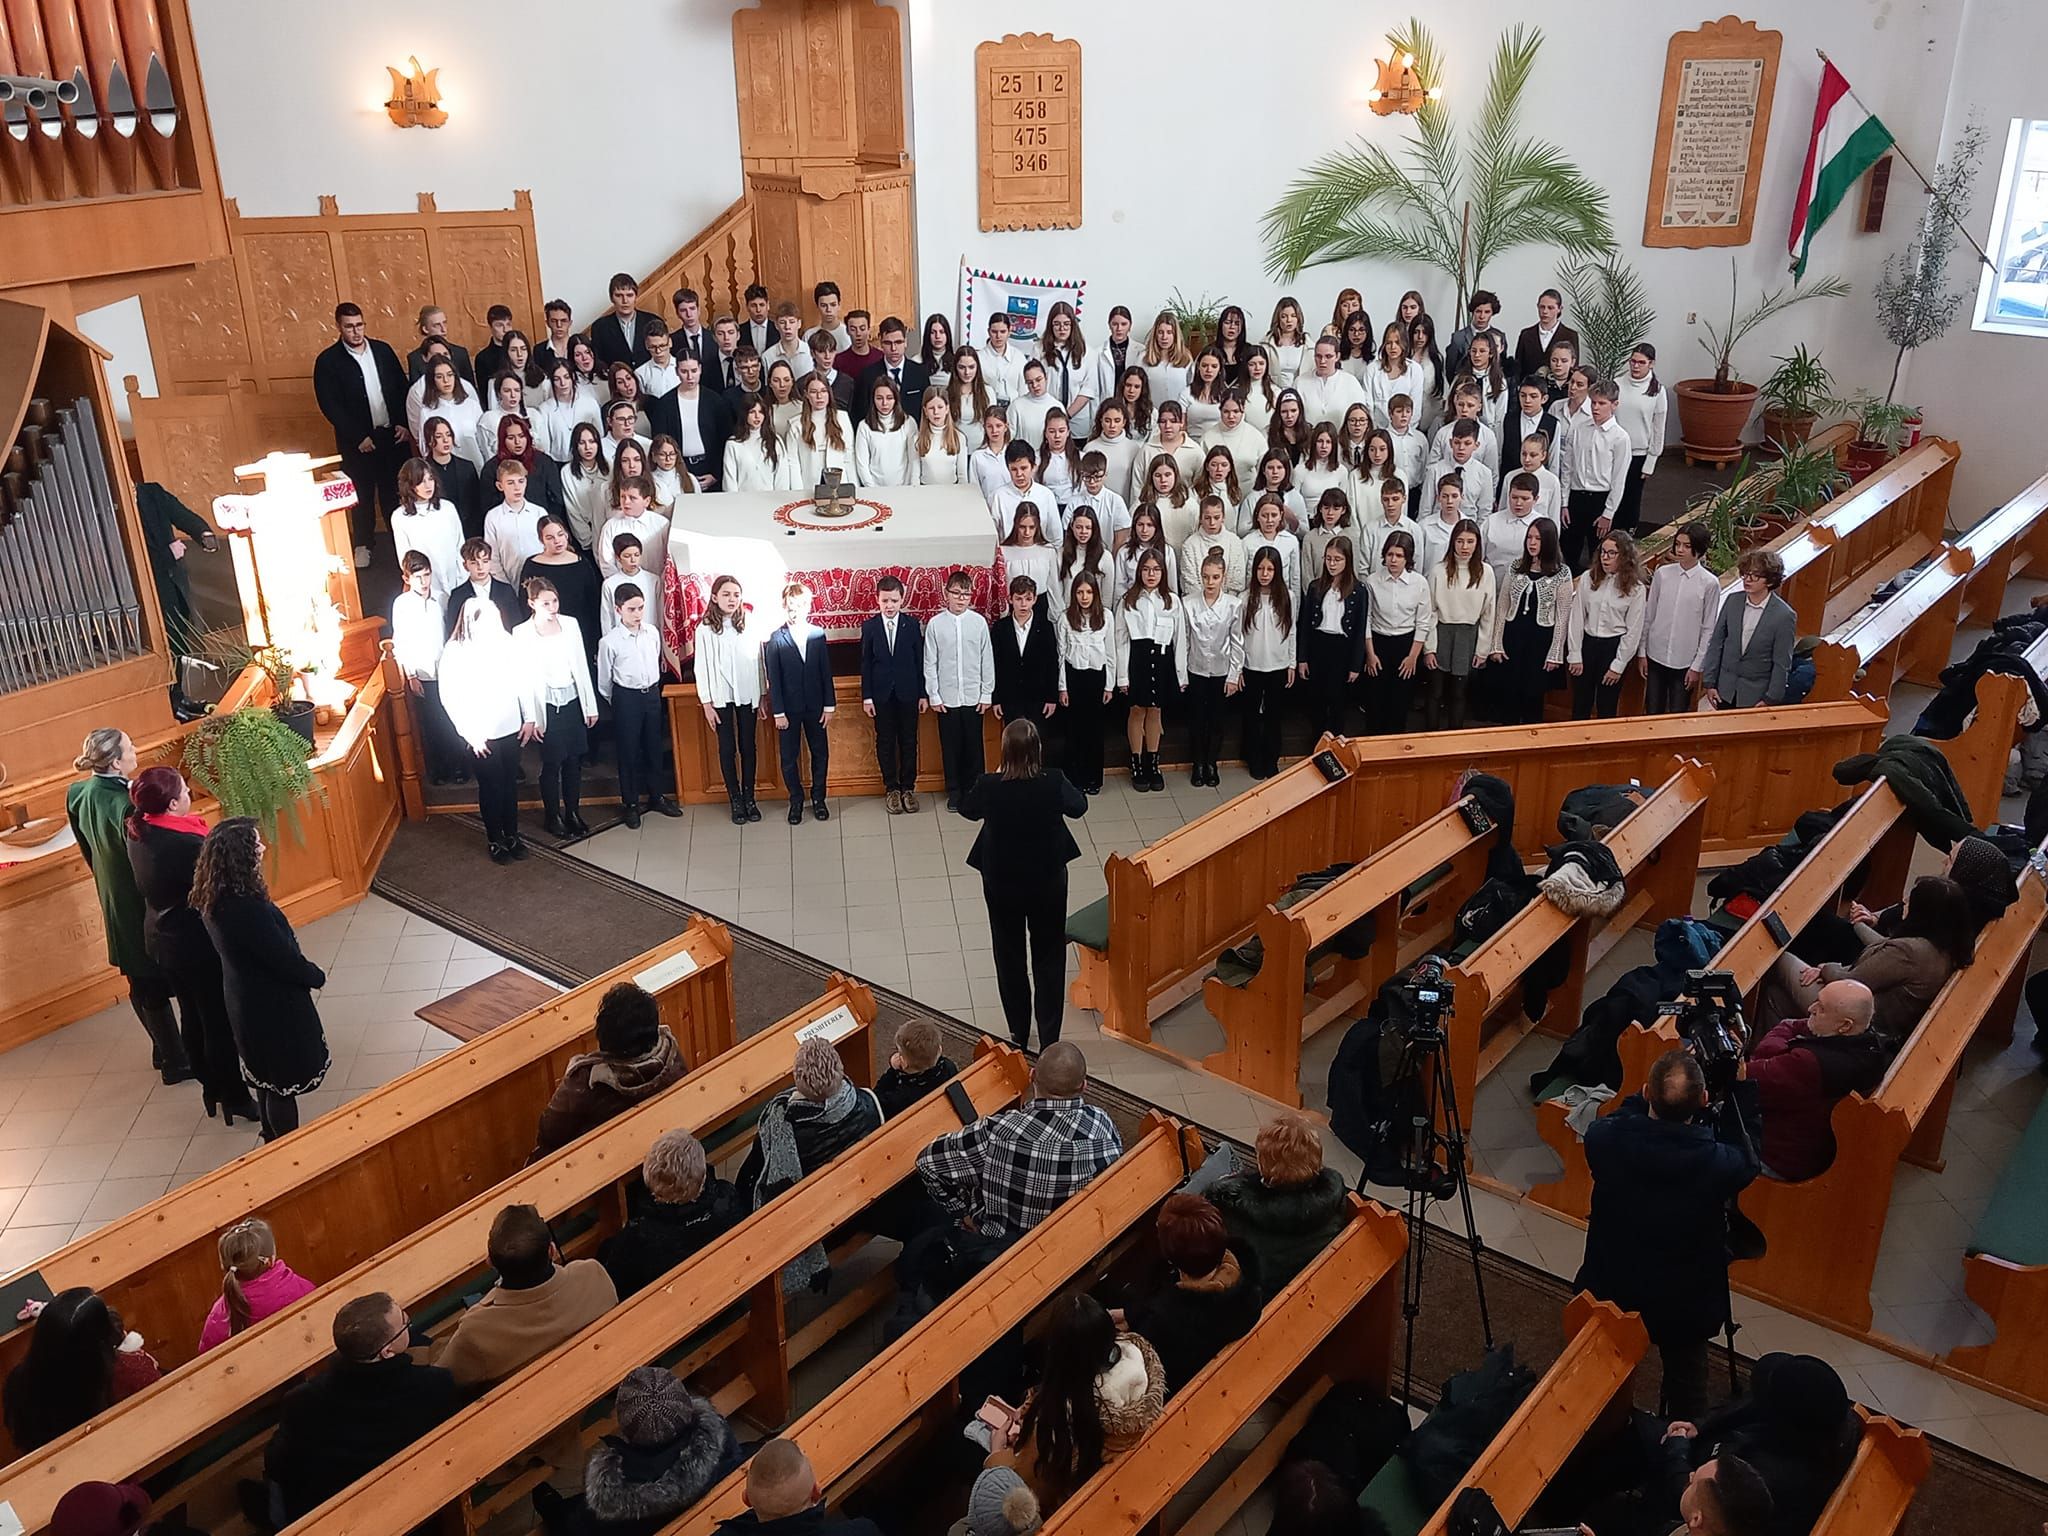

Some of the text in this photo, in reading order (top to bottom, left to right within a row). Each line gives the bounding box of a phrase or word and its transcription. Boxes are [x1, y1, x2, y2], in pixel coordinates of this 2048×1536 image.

[1000, 74, 1064, 93] 25 1 2
[1013, 101, 1047, 120] 458
[1014, 127, 1047, 145] 475
[1014, 153, 1048, 172] 346
[803, 1012, 844, 1039] PRESBITEREK
